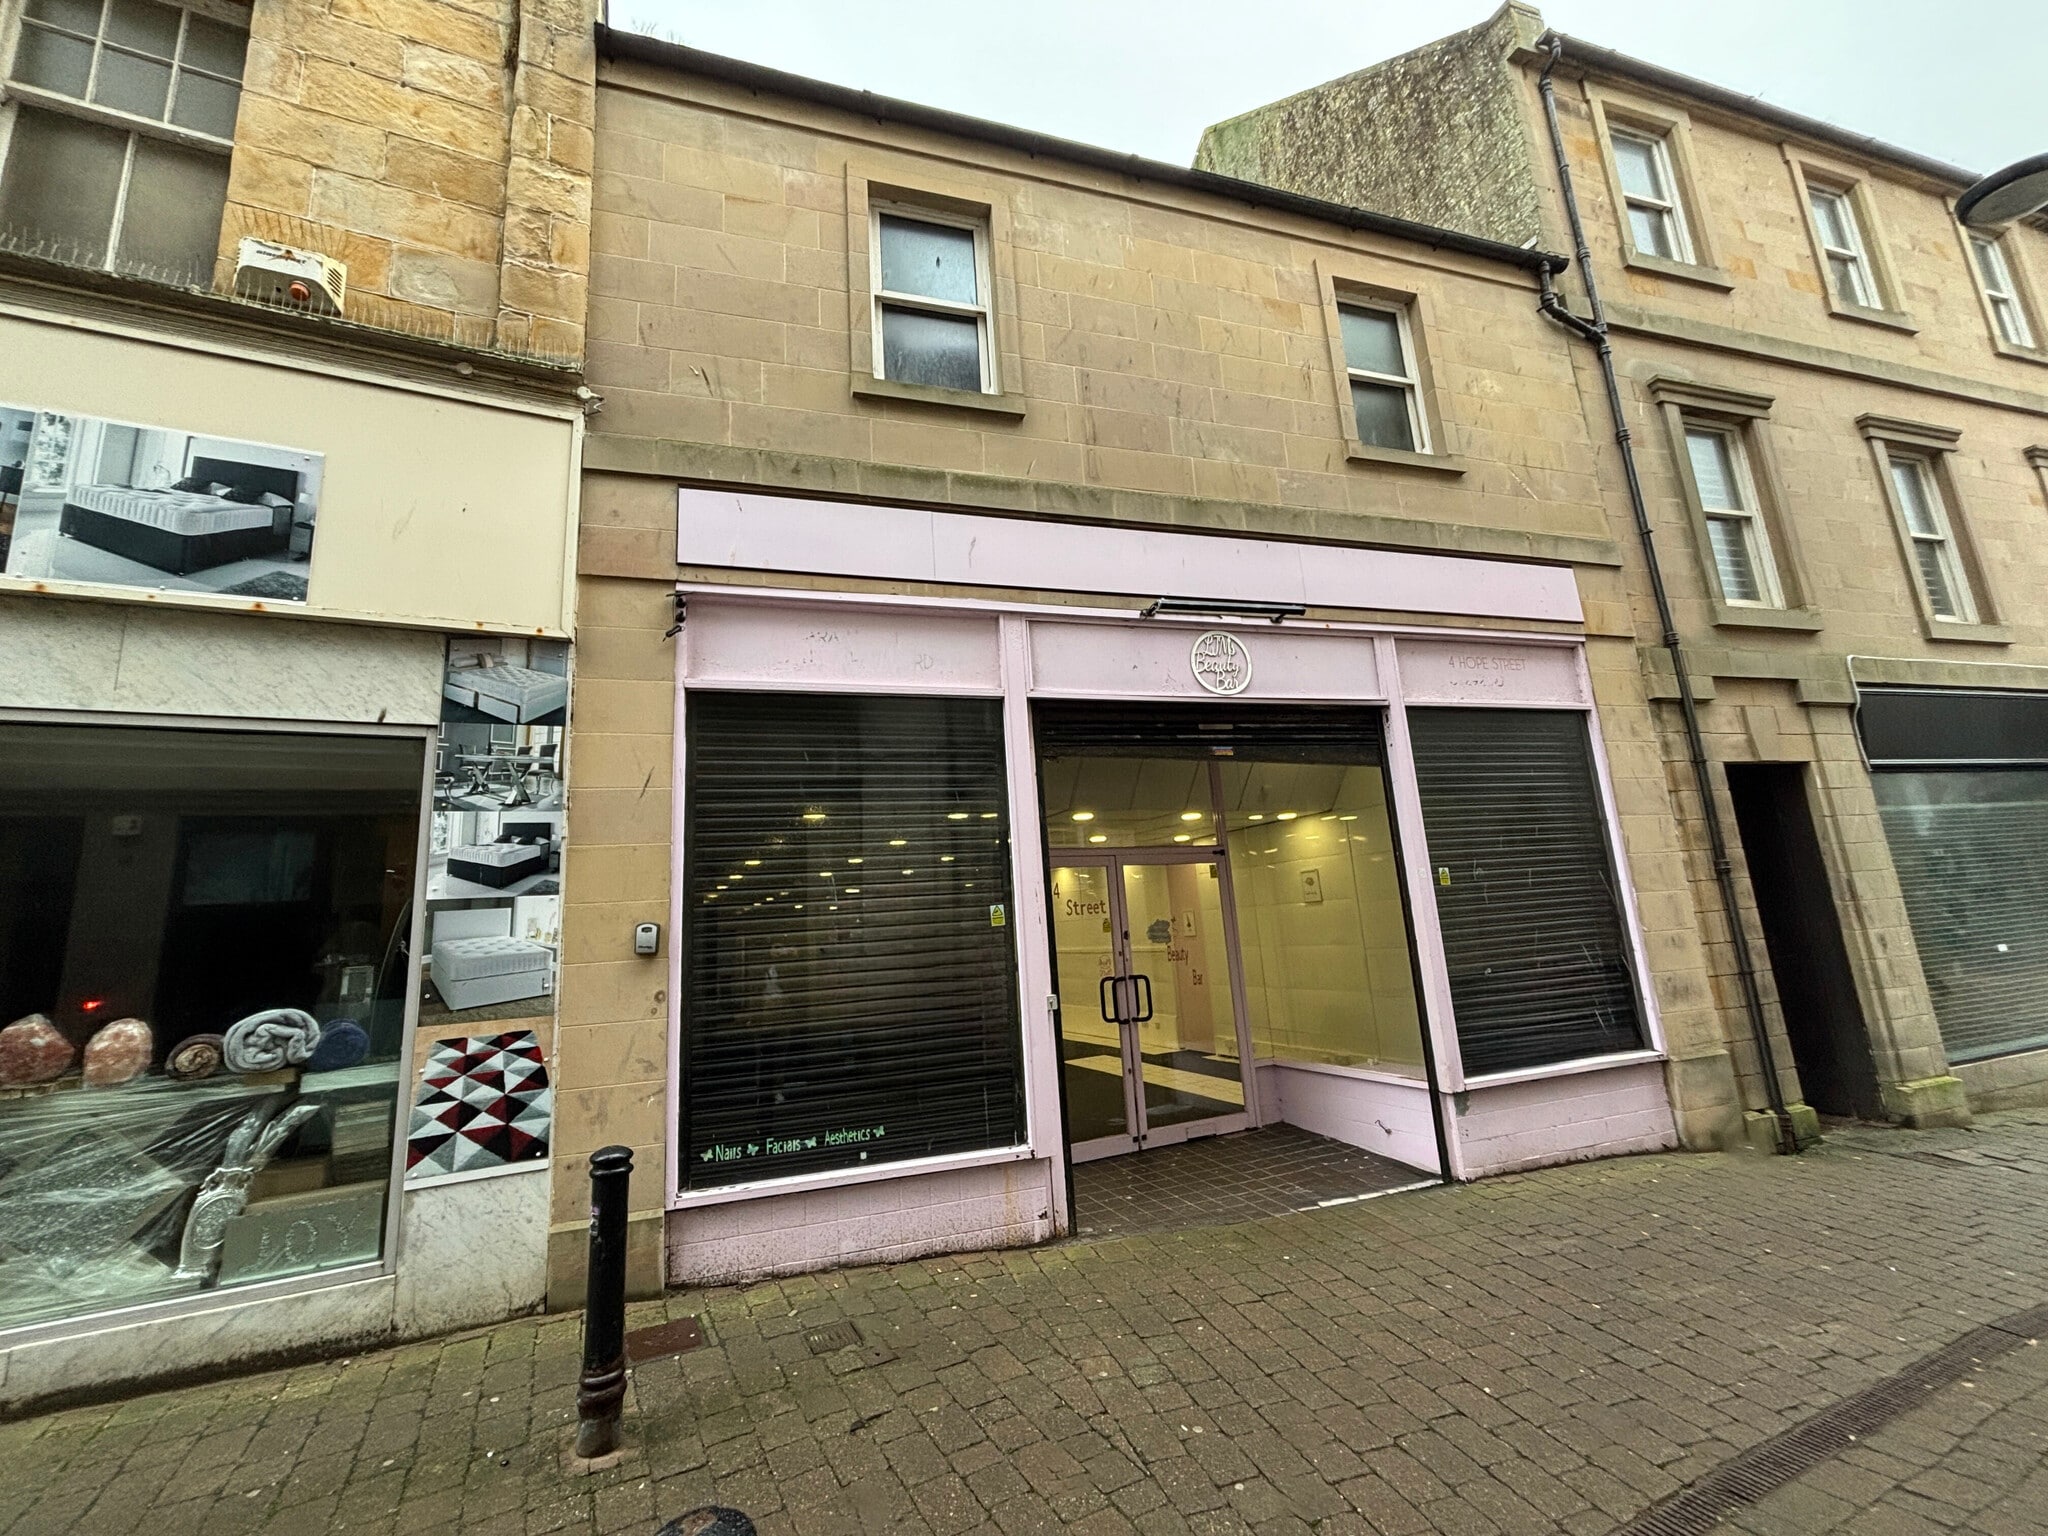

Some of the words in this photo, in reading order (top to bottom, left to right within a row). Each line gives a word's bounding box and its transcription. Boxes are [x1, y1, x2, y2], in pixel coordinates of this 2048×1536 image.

[1195, 652, 1240, 677] Beauty
[1448, 655, 1455, 669] 4
[1459, 656, 1489, 670] HOPE
[1492, 657, 1526, 671] STREET
[1216, 670, 1239, 690] Bar
[1053, 882, 1060, 899] 4
[1066, 898, 1107, 916] Street
[715, 1144, 742, 1162] Nails
[766, 1137, 801, 1155] Facials
[824, 1127, 871, 1147] Aesthetics
